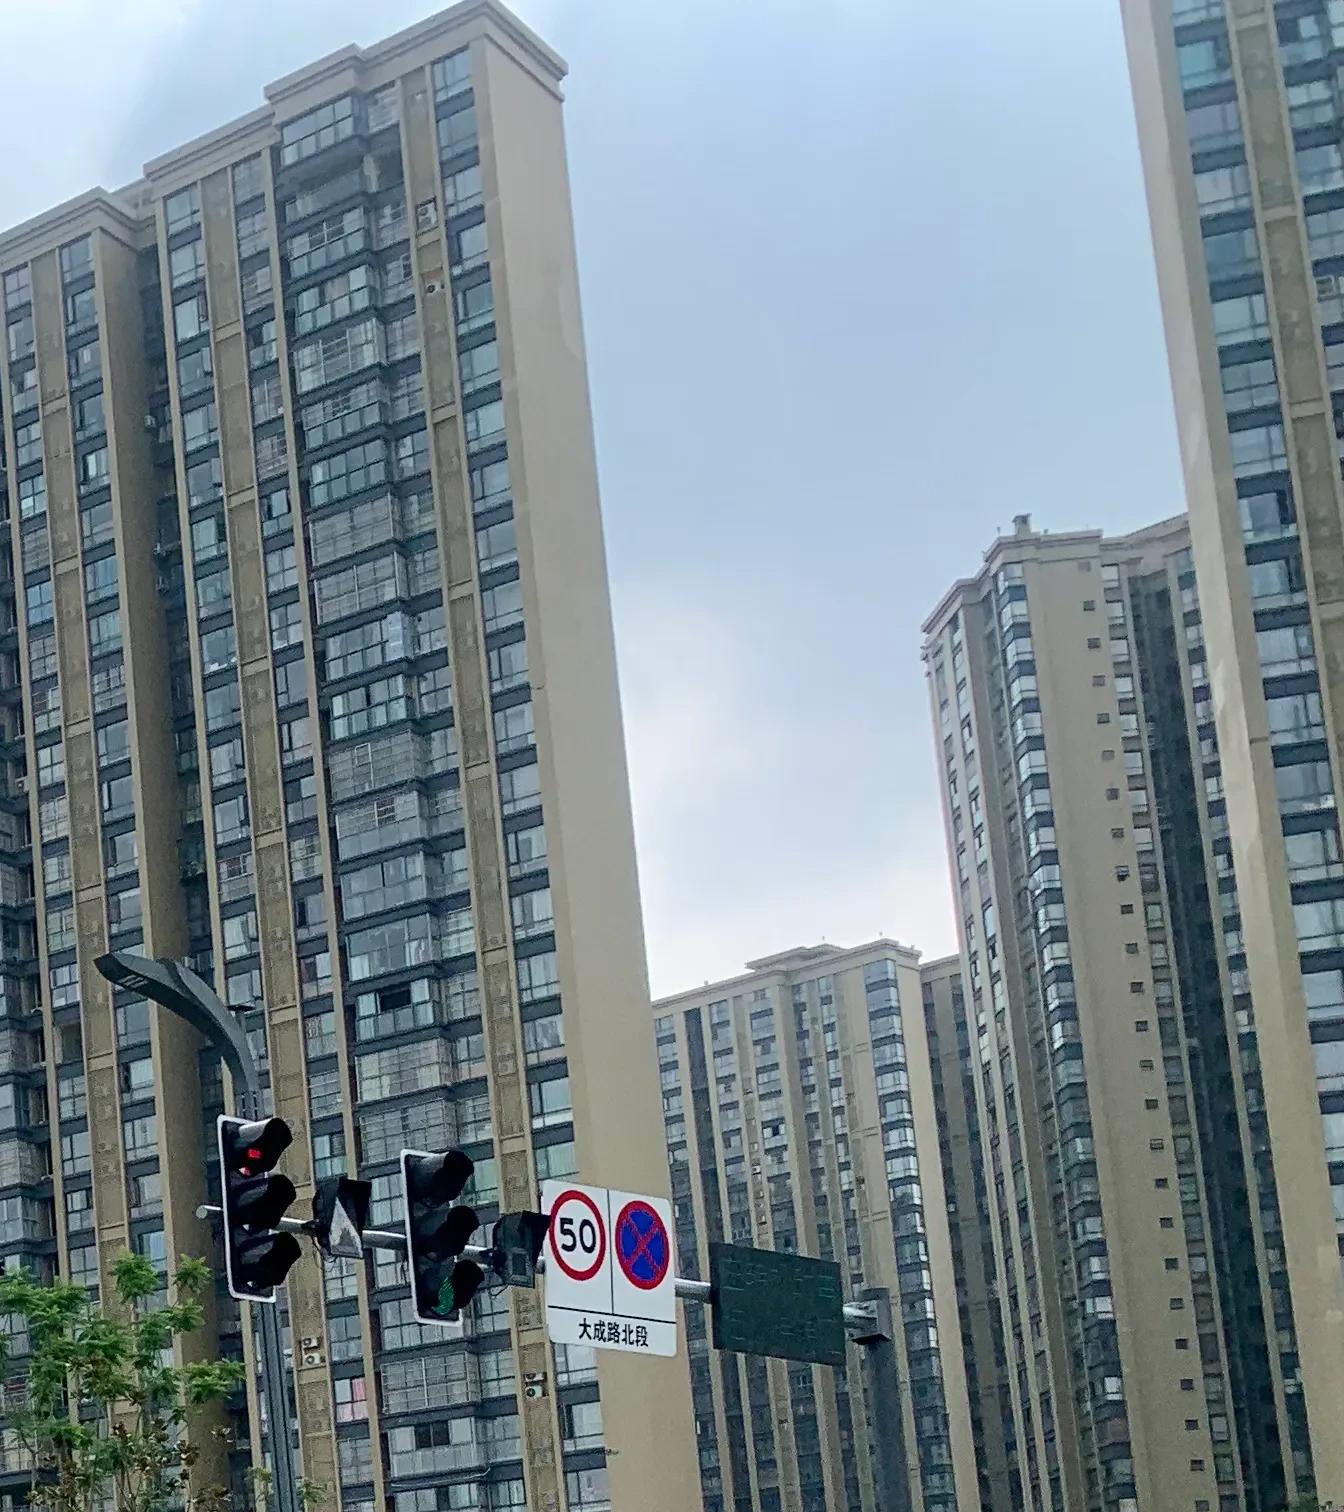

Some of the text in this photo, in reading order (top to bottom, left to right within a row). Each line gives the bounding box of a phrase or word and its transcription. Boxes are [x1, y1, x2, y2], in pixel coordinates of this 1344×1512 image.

[560, 1217, 597, 1254] 50
[578, 1317, 649, 1348] 大成路北段
